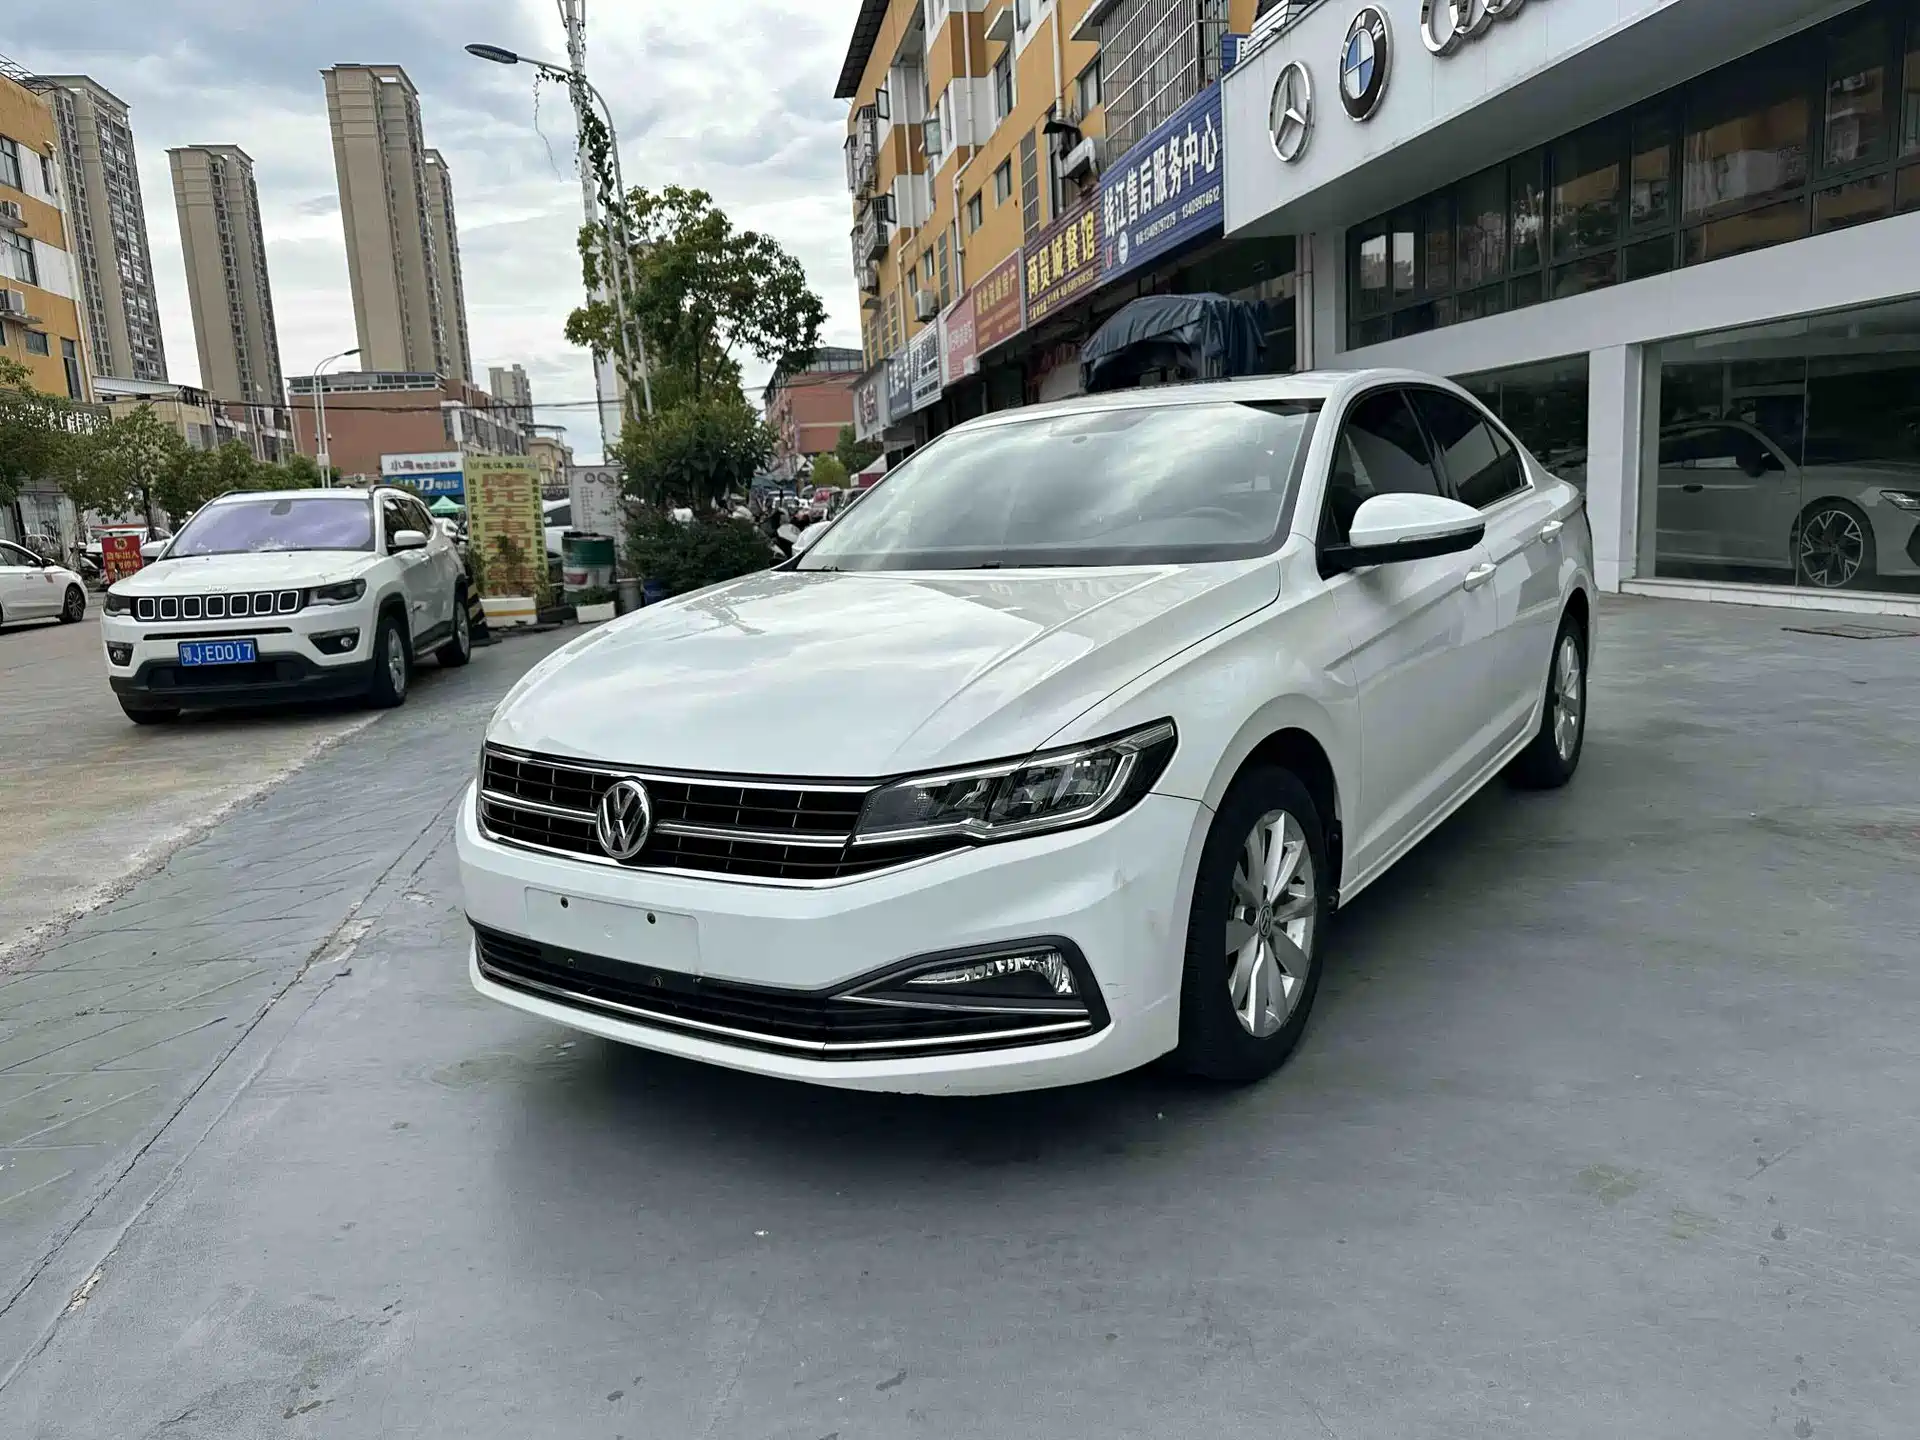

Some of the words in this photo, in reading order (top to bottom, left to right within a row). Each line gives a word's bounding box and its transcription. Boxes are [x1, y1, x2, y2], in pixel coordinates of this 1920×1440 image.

[1103, 112, 1218, 239] 钱江售后服务中心
